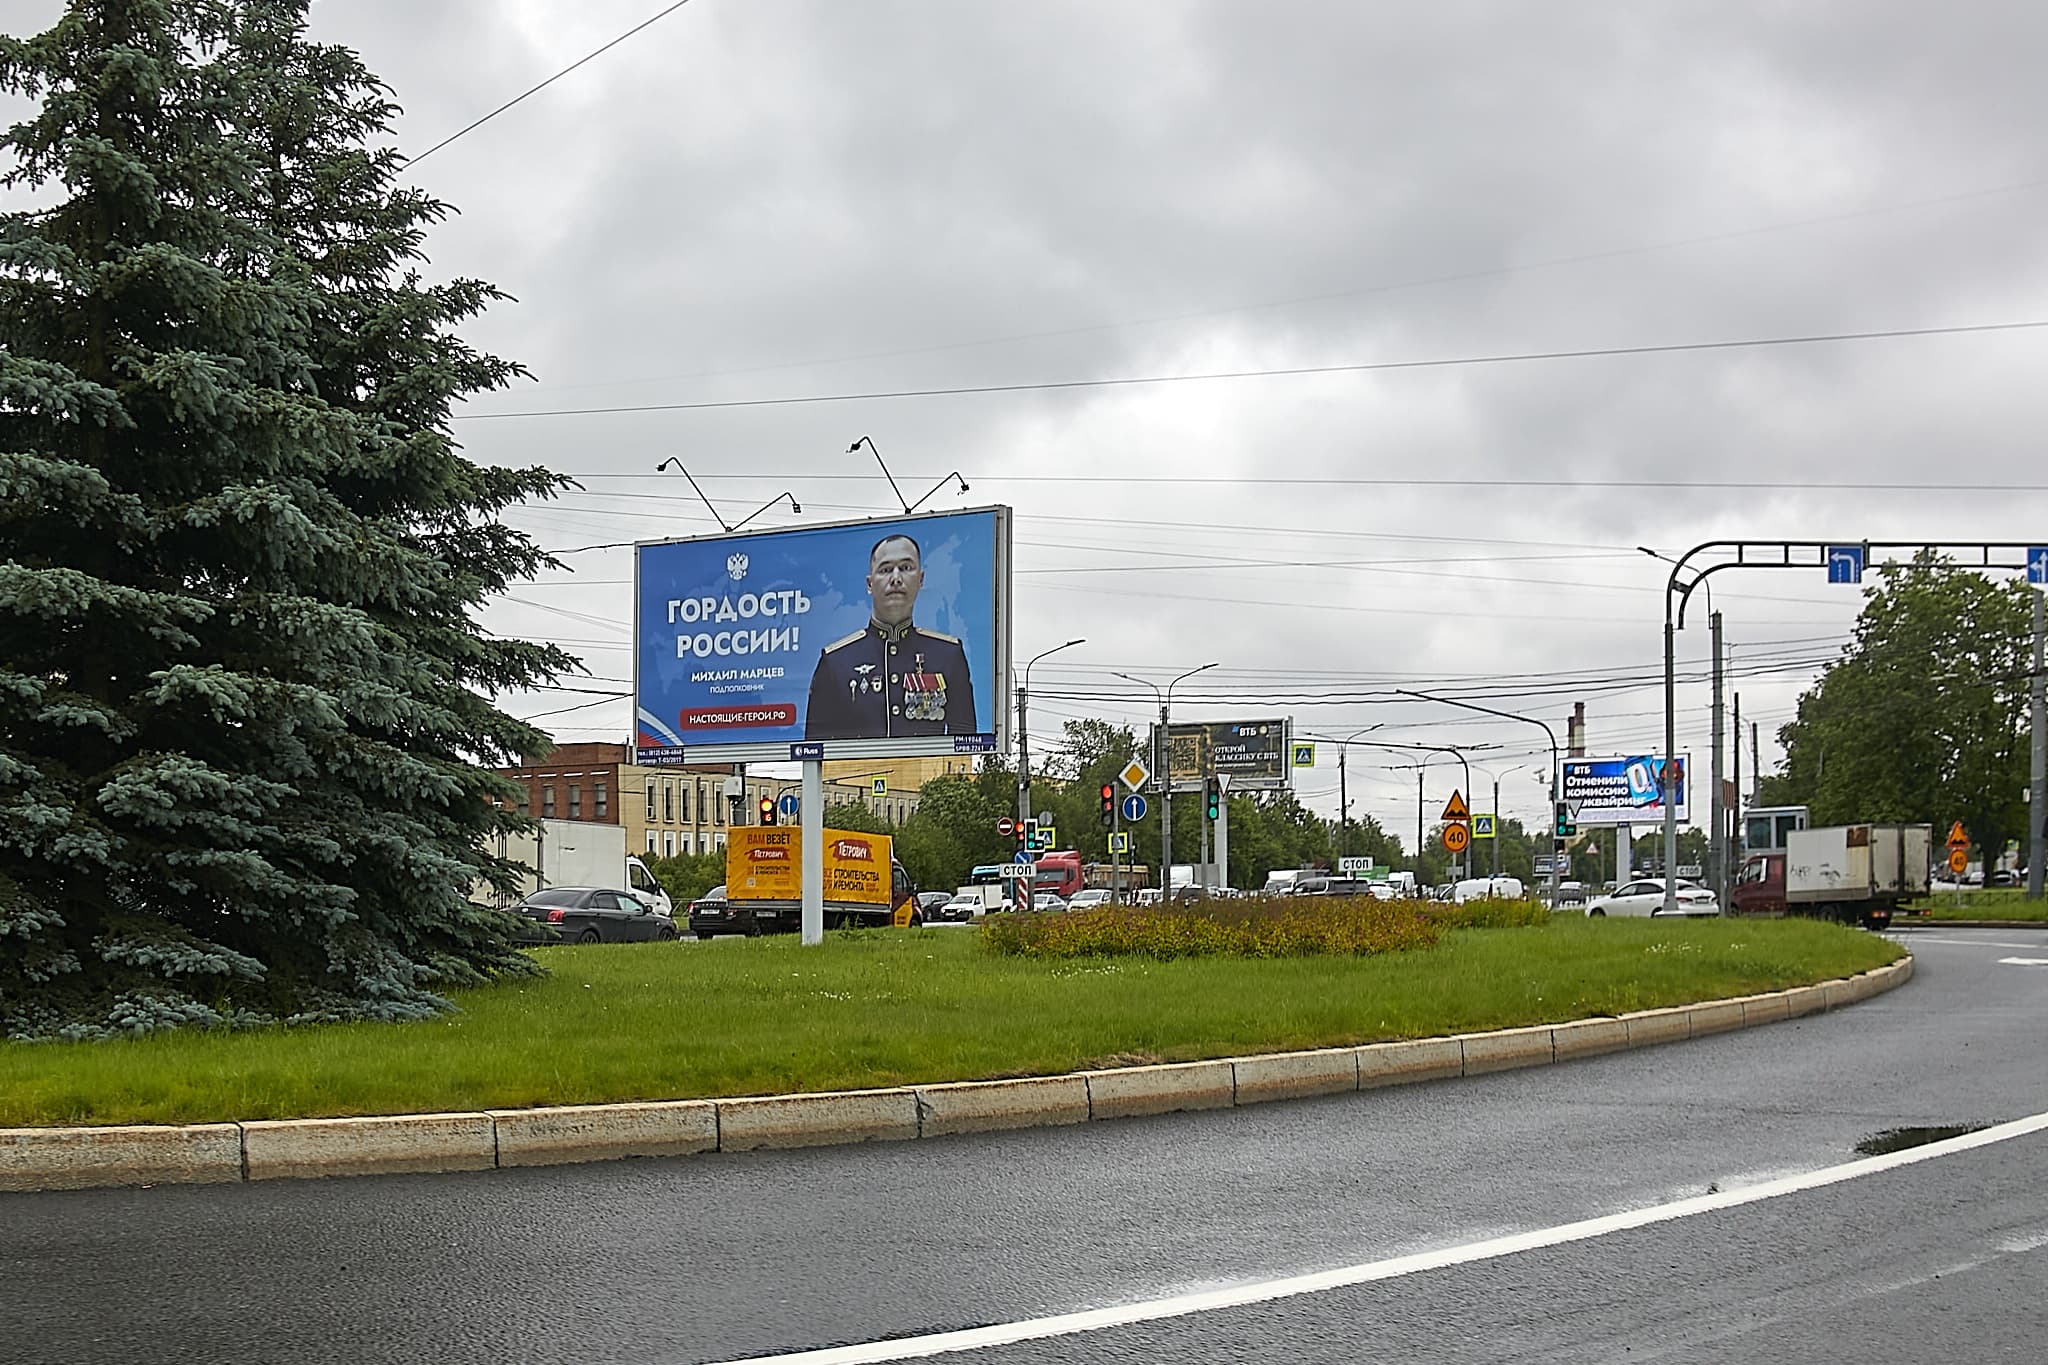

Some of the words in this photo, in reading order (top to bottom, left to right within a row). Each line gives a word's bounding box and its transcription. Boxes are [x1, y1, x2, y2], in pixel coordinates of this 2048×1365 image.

[668, 590, 811, 623] ГОРДОСТЬ
[677, 627, 800, 658] РОССИИ!
[691, 670, 737, 682] МИХАИЛ
[740, 667, 784, 680] МАРЦЕВ
[689, 711, 786, 724] НАСТОЯЩИЕ-ГЕРОИ.РФ
[1239, 727, 1257, 737] ВТБ
[803, 747, 818, 755] Russ
[1574, 766, 1591, 775] ВТБ
[1566, 776, 1628, 787] Отменили
[1566, 786, 1628, 798] комиссию
[747, 834, 765, 845] ВАМ
[766, 833, 790, 845] ВЕЗЁТ
[1448, 832, 1464, 843] 40
[1343, 859, 1368, 869] СТОП
[1004, 866, 1031, 875] СТОП
